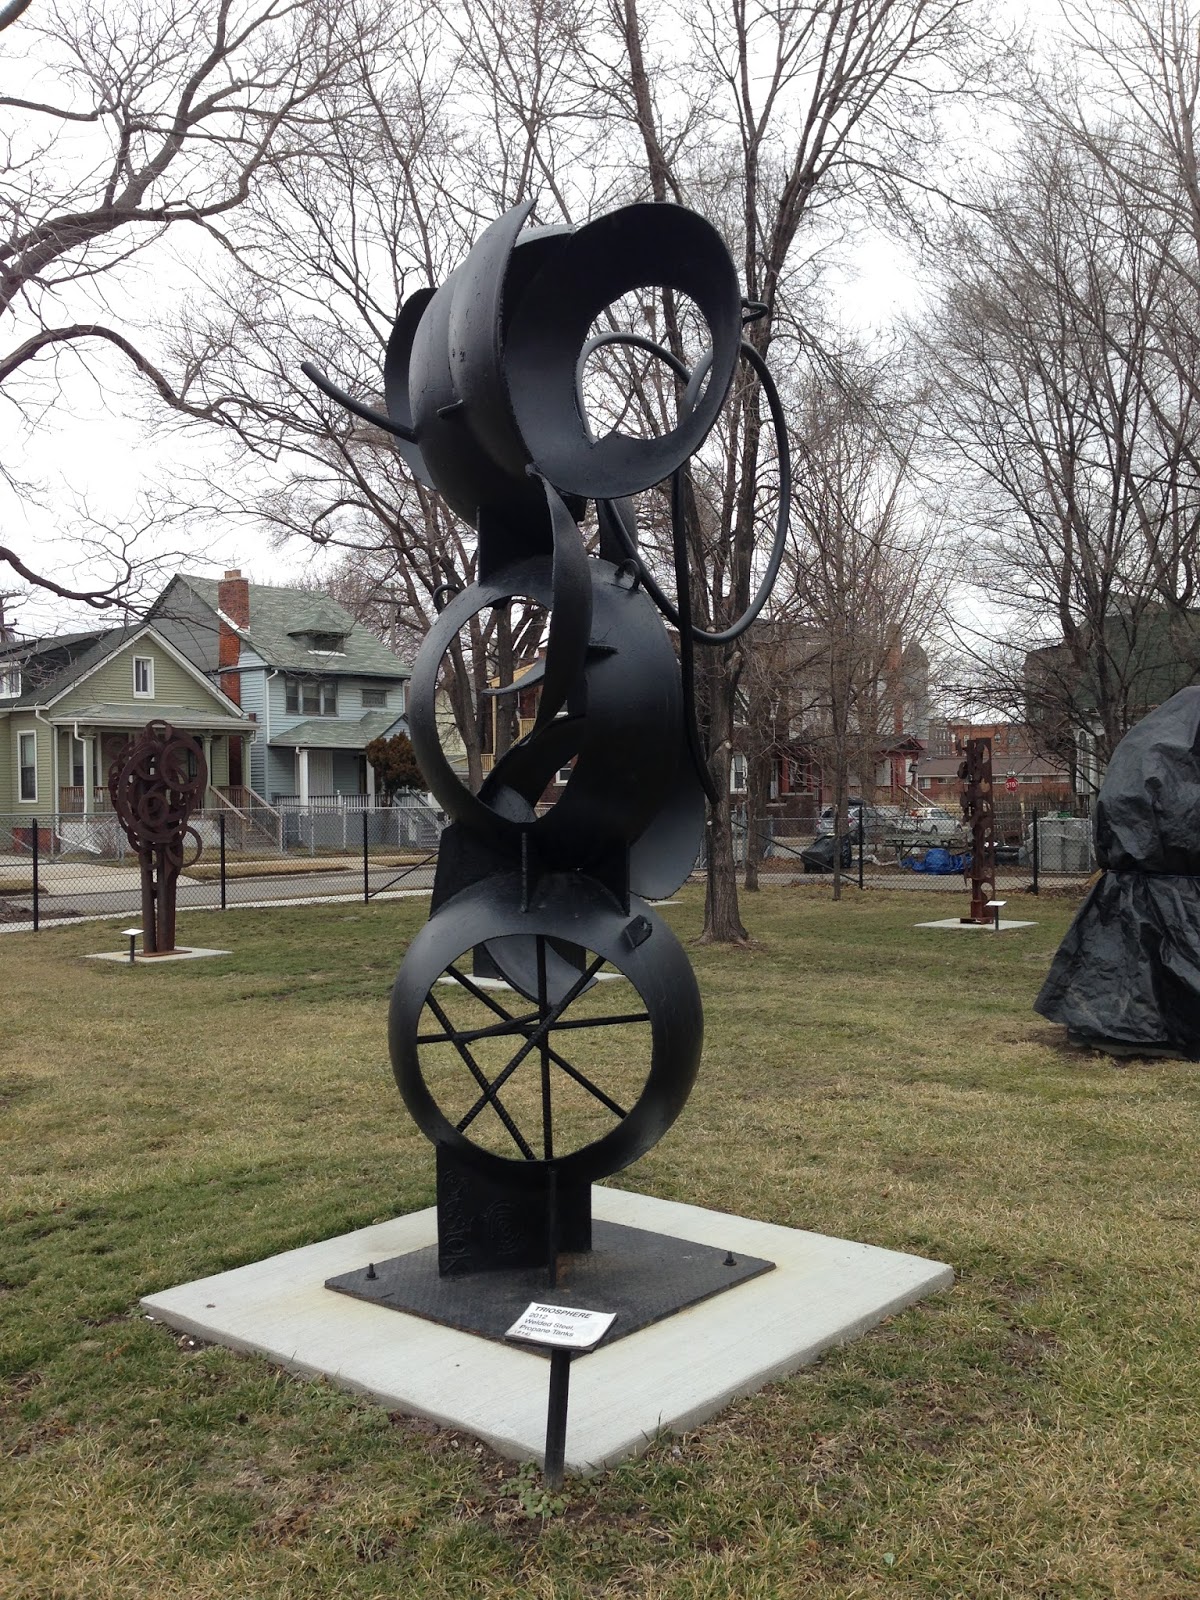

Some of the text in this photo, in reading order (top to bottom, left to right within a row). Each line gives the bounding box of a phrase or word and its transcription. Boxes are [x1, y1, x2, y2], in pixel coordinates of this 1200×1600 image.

[535, 1306, 592, 1319] TRIOSPHERE
[519, 1325, 574, 1337] Propane Tanks
[525, 1318, 574, 1331] Welded Steel,
